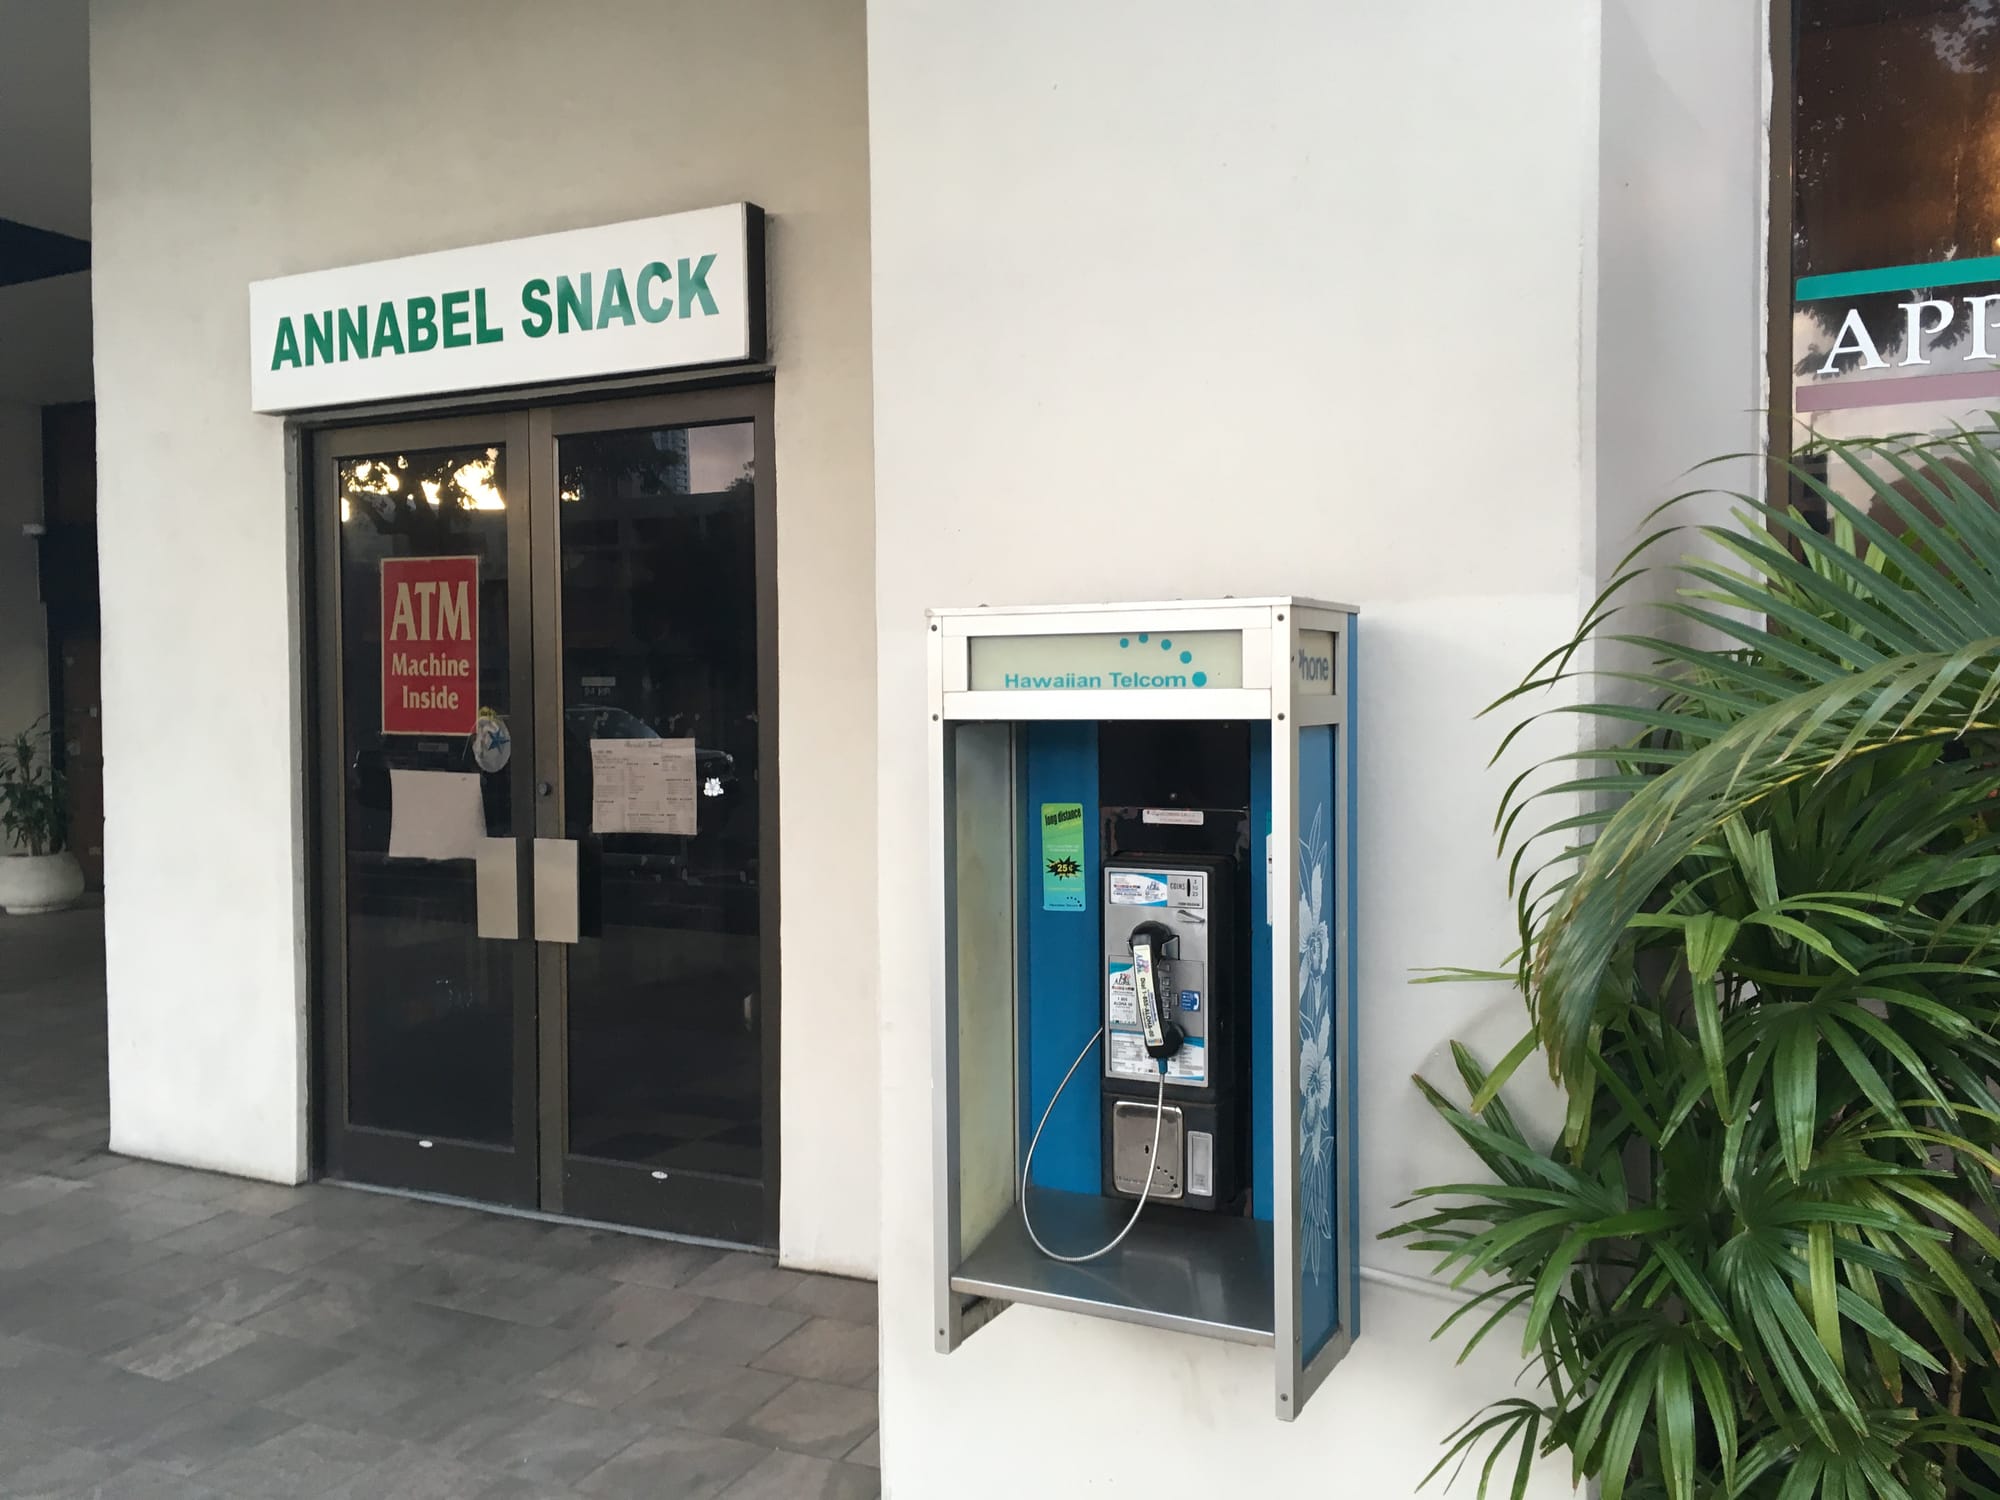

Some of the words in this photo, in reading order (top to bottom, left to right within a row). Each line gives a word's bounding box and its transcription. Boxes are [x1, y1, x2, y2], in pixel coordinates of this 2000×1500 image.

[271, 287, 503, 371] ANNABEL
[522, 253, 720, 339] SNACK
[389, 580, 471, 642] ATM
[391, 652, 470, 679] Machine
[1004, 671, 1102, 689] Hawaiian
[1108, 671, 1187, 688] Telcom
[401, 684, 459, 711] Inside
[1058, 807, 1082, 824] distance
